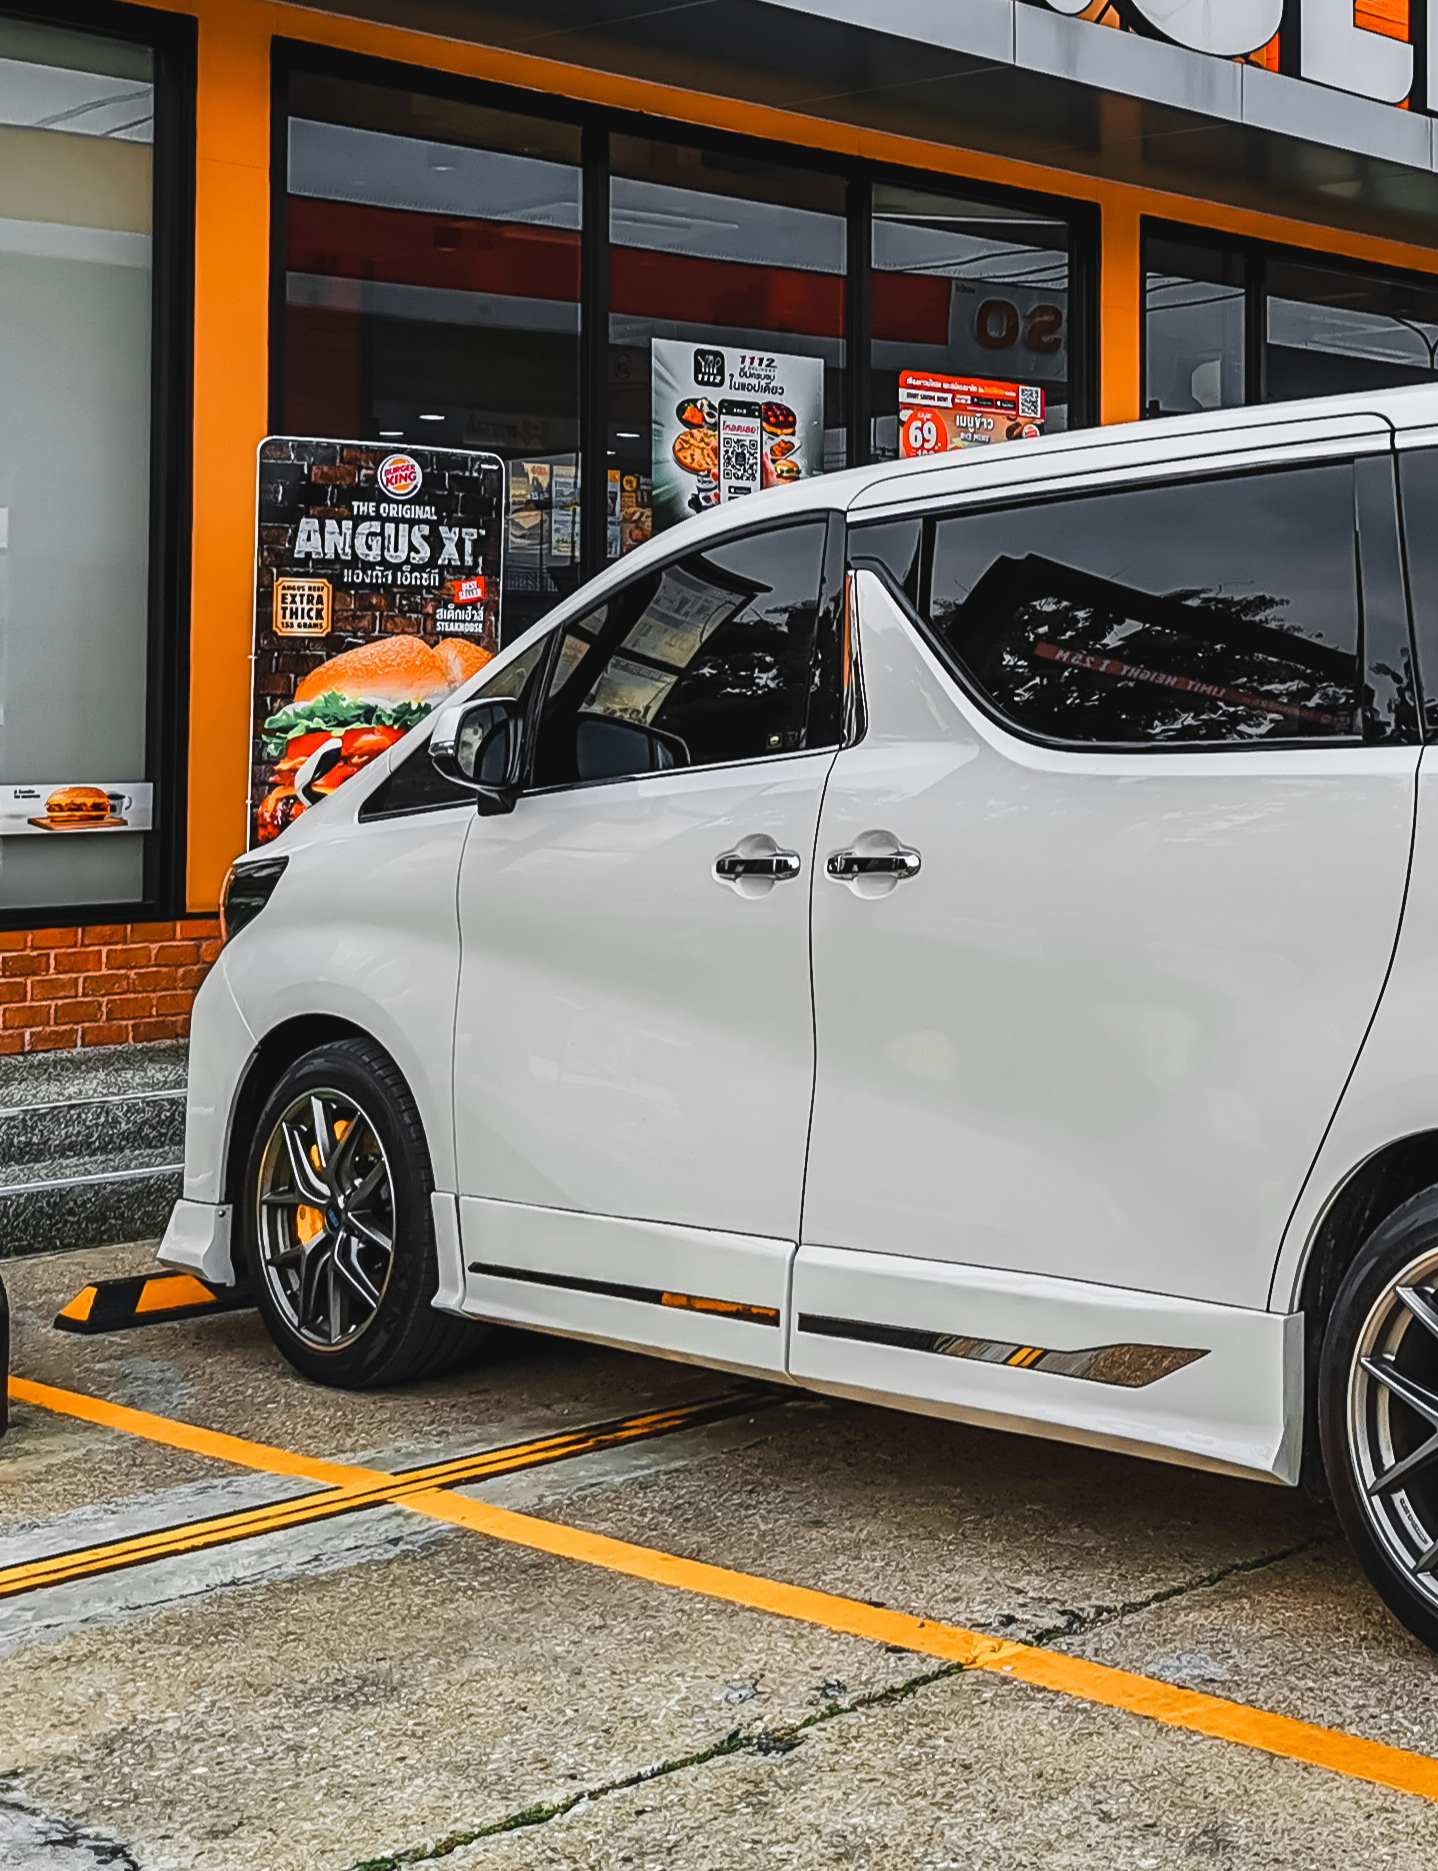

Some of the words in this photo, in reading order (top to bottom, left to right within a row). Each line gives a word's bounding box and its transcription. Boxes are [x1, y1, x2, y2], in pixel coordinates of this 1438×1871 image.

[740, 354, 778, 368] 1112
[385, 471, 417, 487] KING
[352, 501, 376, 516] THE
[379, 502, 438, 520] ORIGINAL
[294, 518, 431, 564] ANGUS
[281, 592, 325, 606] EXTRA
[281, 606, 325, 620] THICK
[436, 621, 483, 633] STEAKHOUSE
